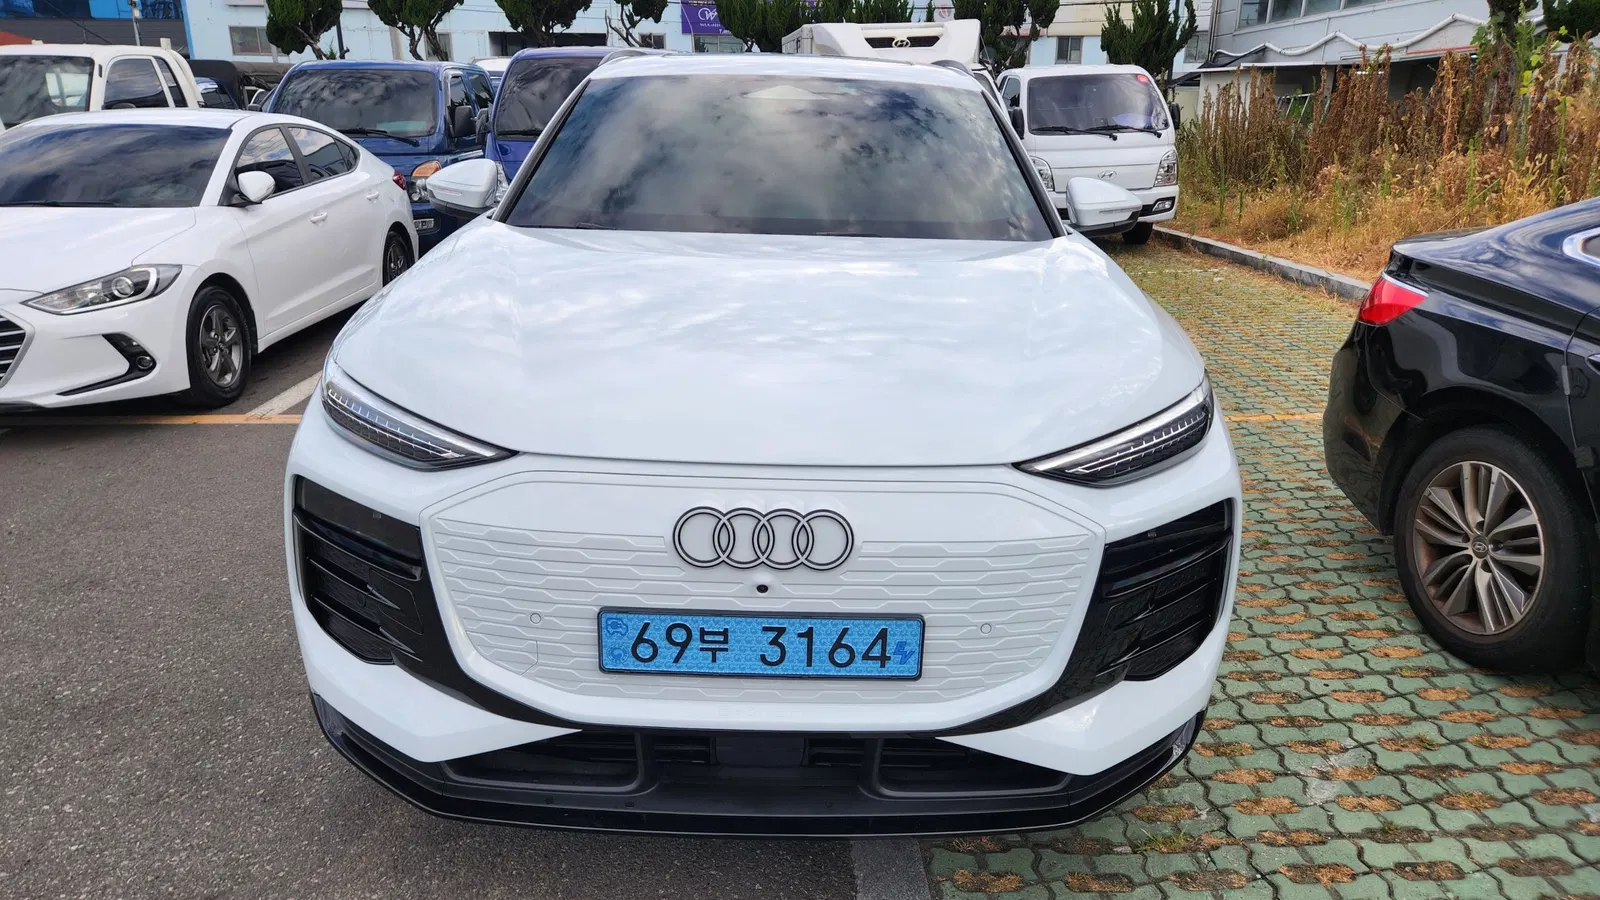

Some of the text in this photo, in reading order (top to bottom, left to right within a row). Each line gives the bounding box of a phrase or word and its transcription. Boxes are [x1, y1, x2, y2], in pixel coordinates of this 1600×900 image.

[631, 622, 892, 669] 69부 3164
[893, 641, 915, 665] EV
